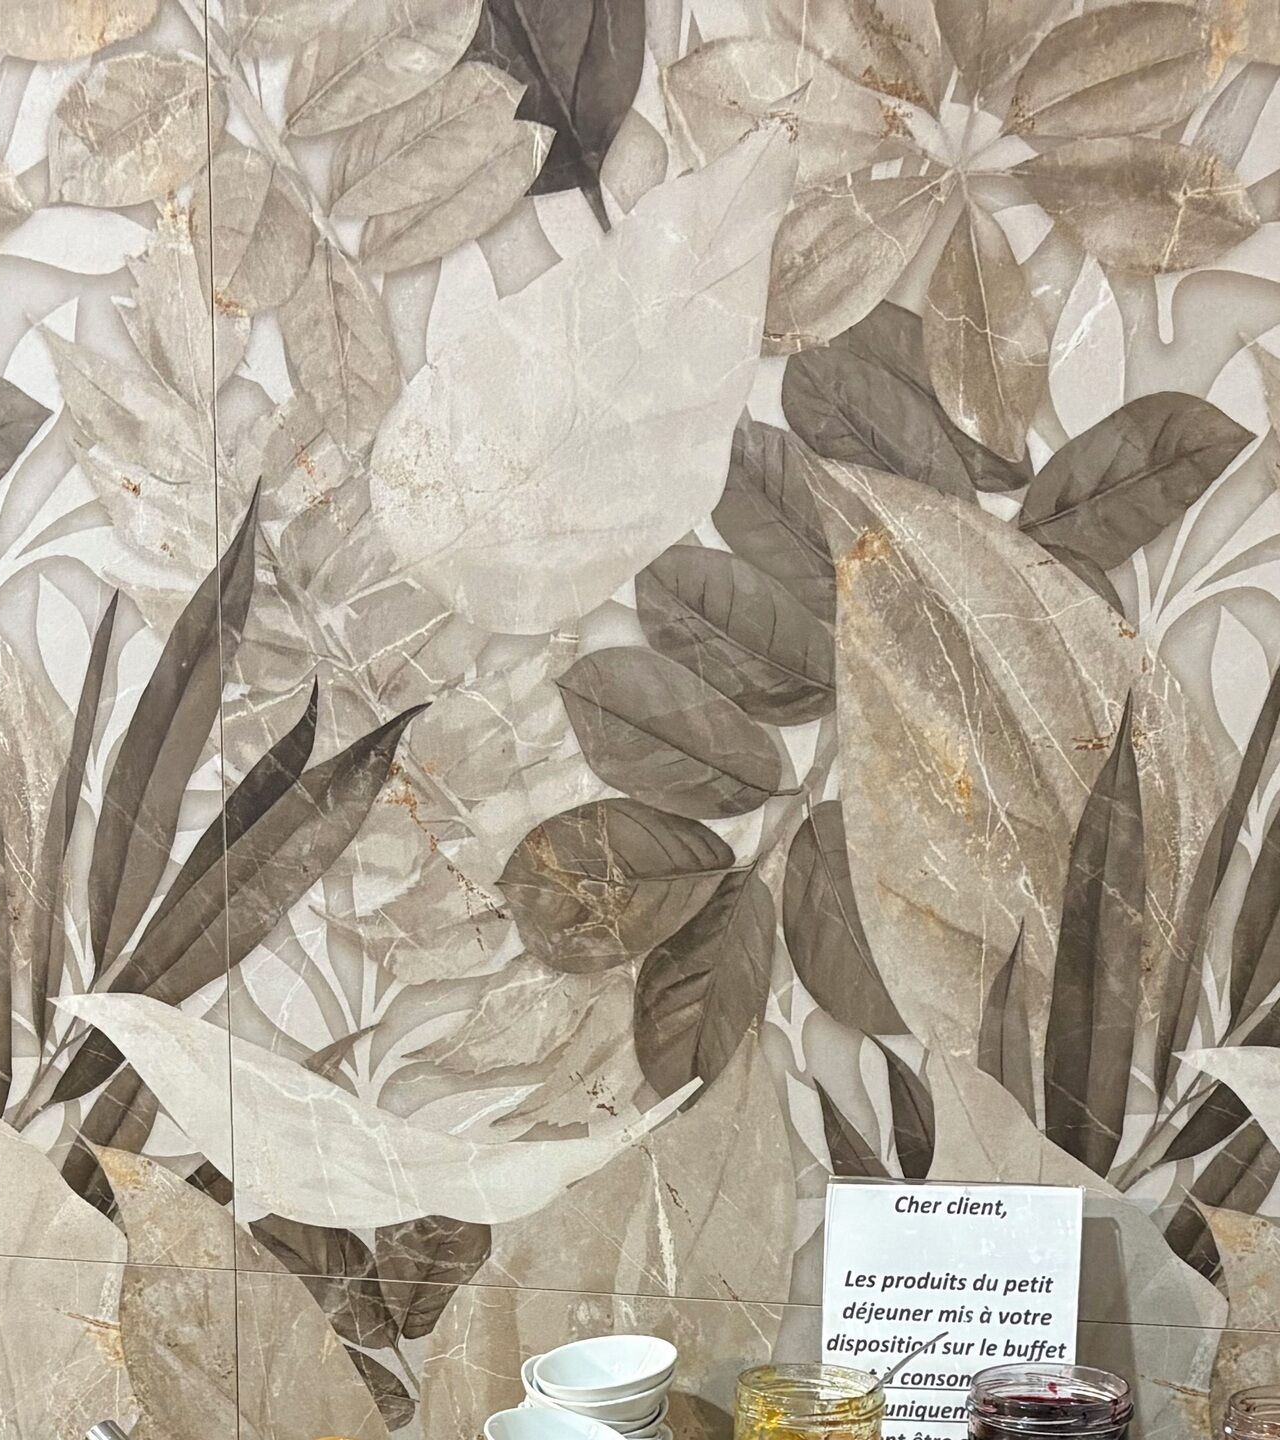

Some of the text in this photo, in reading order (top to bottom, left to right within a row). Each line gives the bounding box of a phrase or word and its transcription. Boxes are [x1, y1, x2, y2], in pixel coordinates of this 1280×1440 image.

[894, 1196, 1008, 1219] Cher client,
[844, 1270, 1054, 1296] Les produits du petit
[842, 1302, 1052, 1326] déjeuner mis à votre
[942, 1341, 974, 1356] sur
[979, 1338, 998, 1357] le
[1003, 1340, 1067, 1362] buffet
